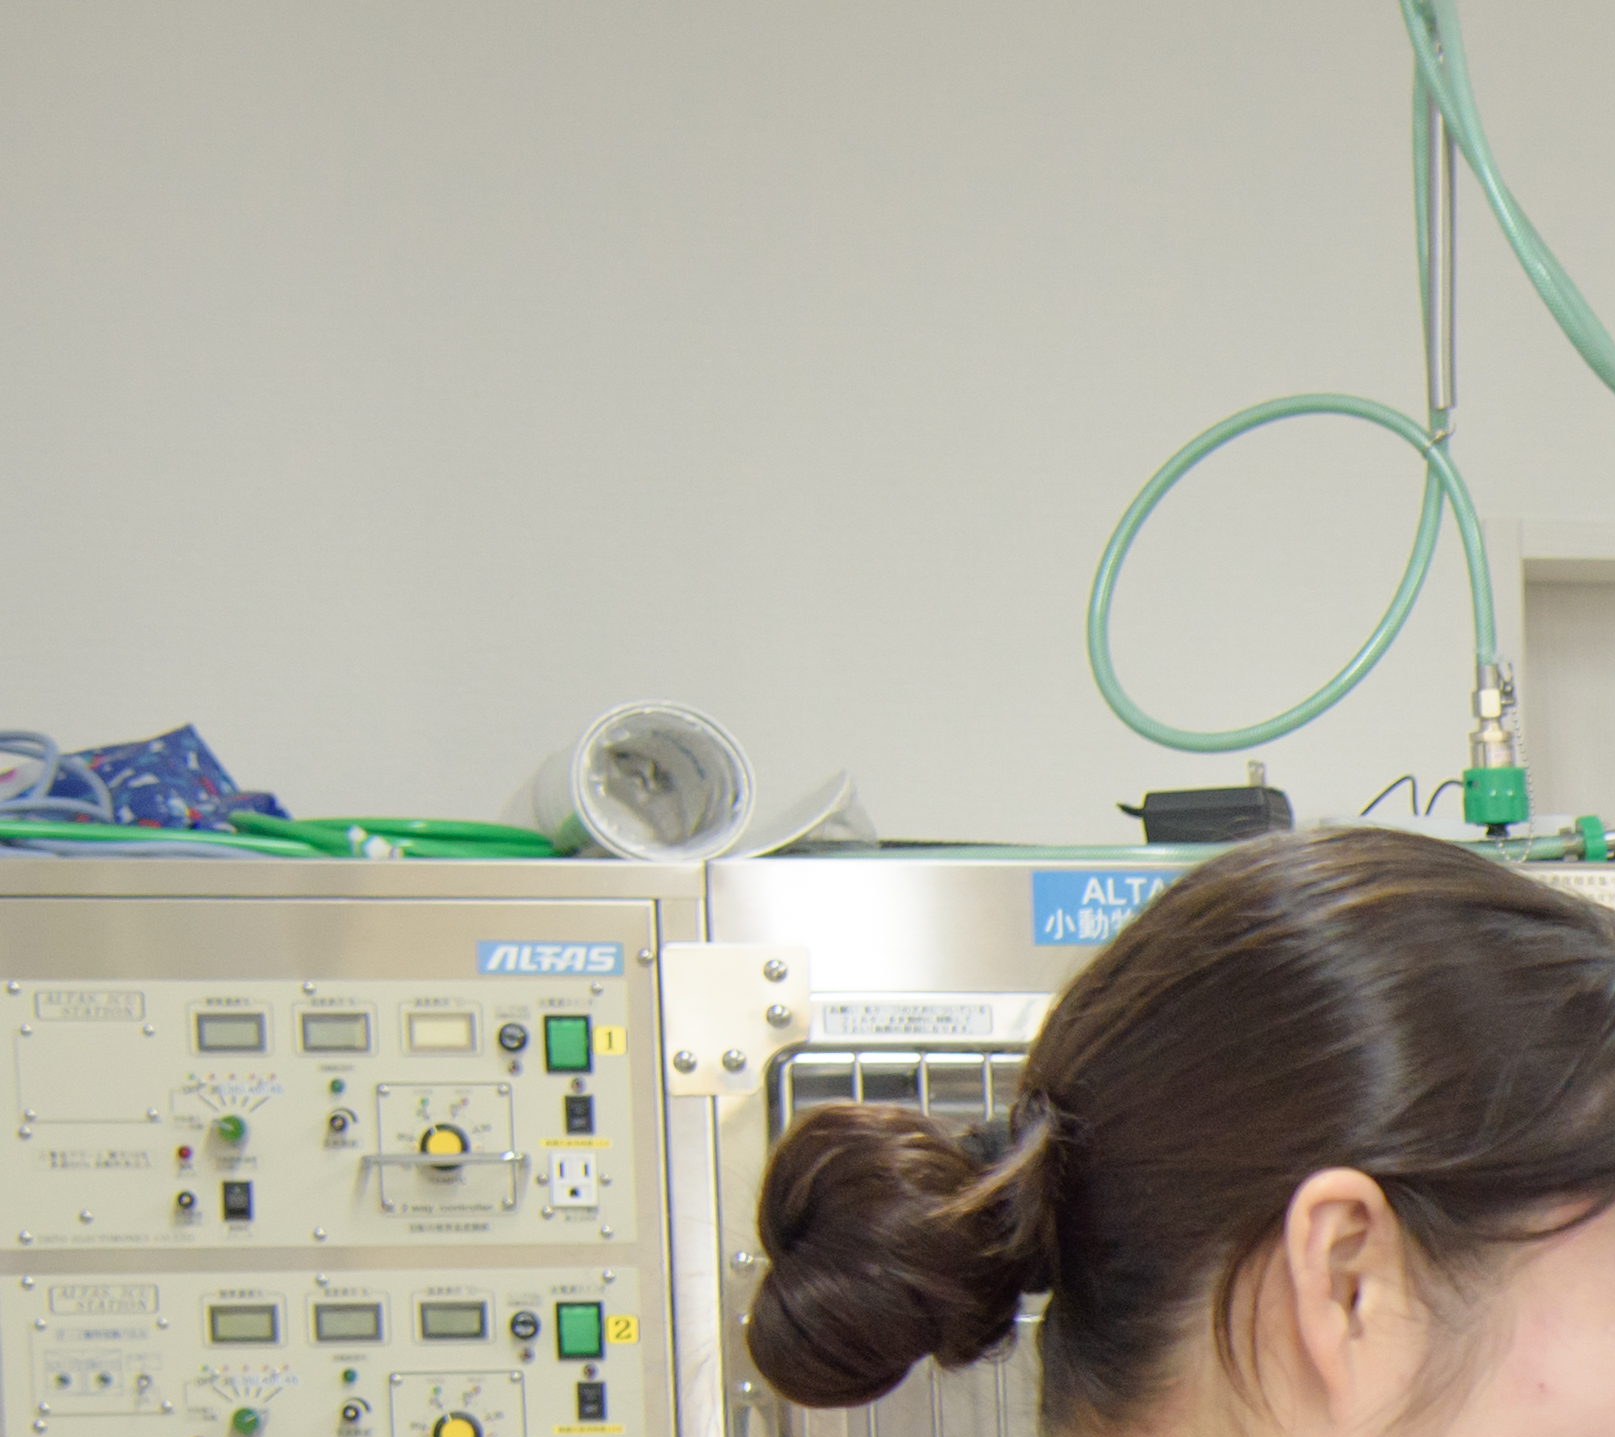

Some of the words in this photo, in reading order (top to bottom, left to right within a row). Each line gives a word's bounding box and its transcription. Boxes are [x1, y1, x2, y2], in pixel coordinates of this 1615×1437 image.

[1082, 877, 1166, 906] ALTA
[487, 944, 616, 972] ALTAS
[606, 1031, 614, 1051] 1
[613, 1319, 632, 1340] 2
